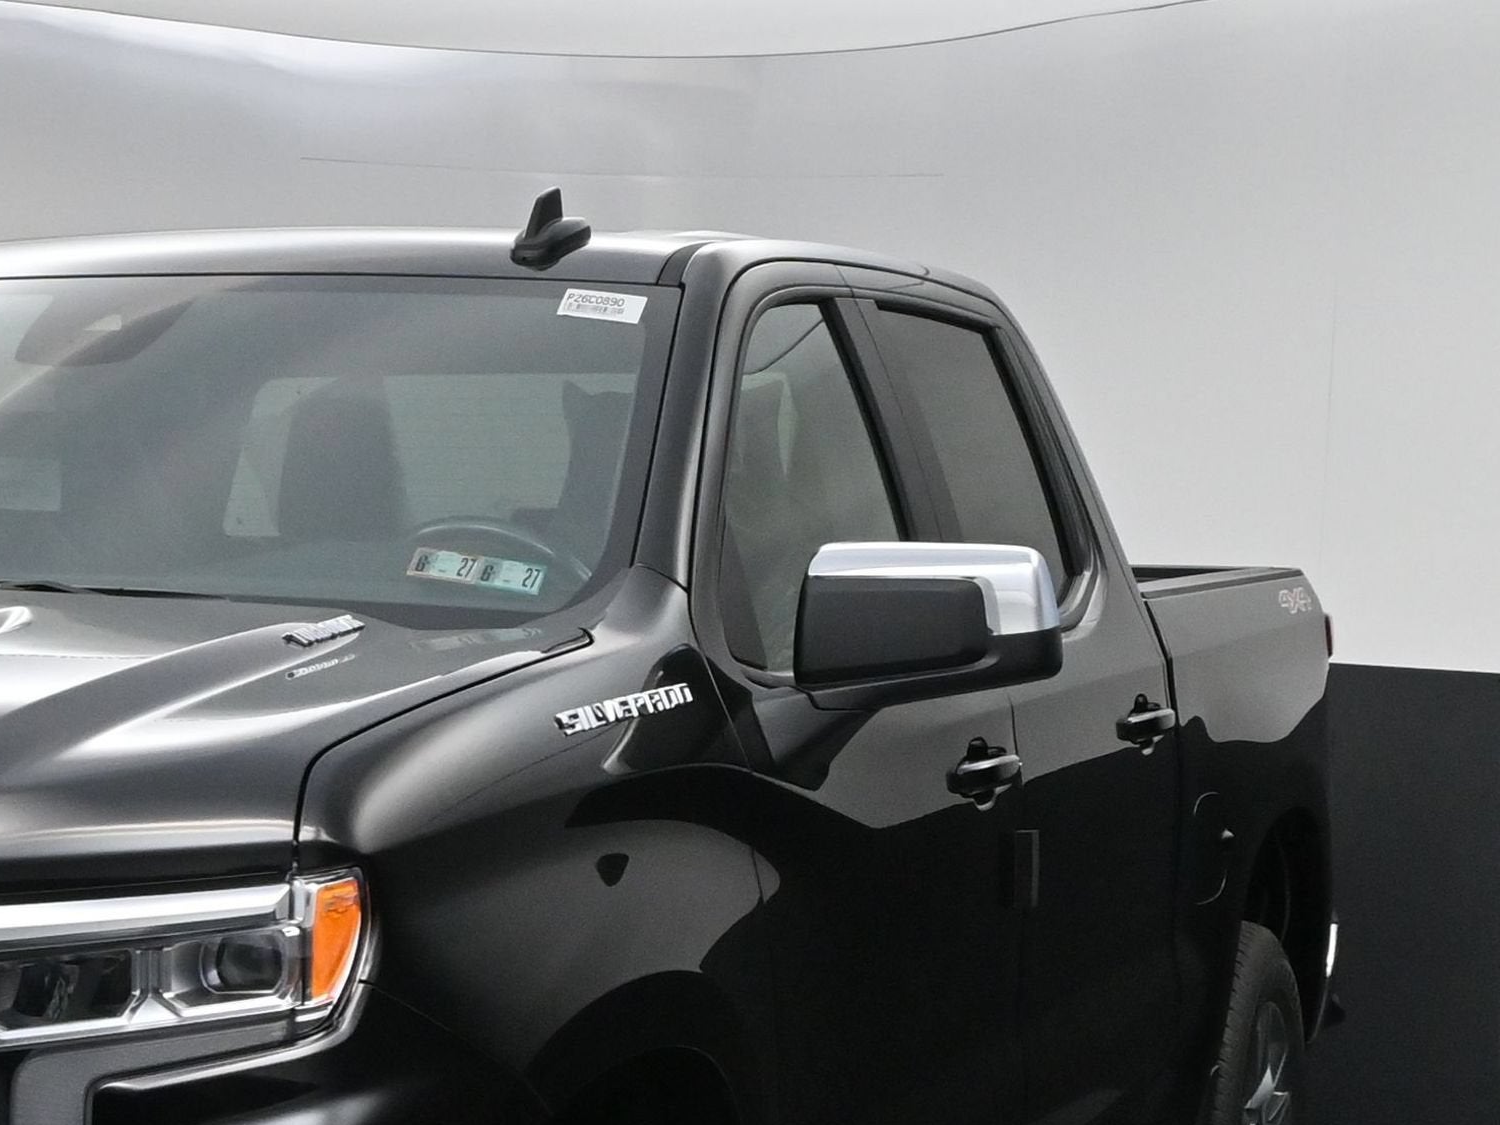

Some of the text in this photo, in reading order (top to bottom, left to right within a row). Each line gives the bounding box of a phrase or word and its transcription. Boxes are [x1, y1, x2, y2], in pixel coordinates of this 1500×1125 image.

[456, 557, 478, 578] 27
[522, 567, 541, 589] 27
[554, 682, 694, 736] SILVERADO
